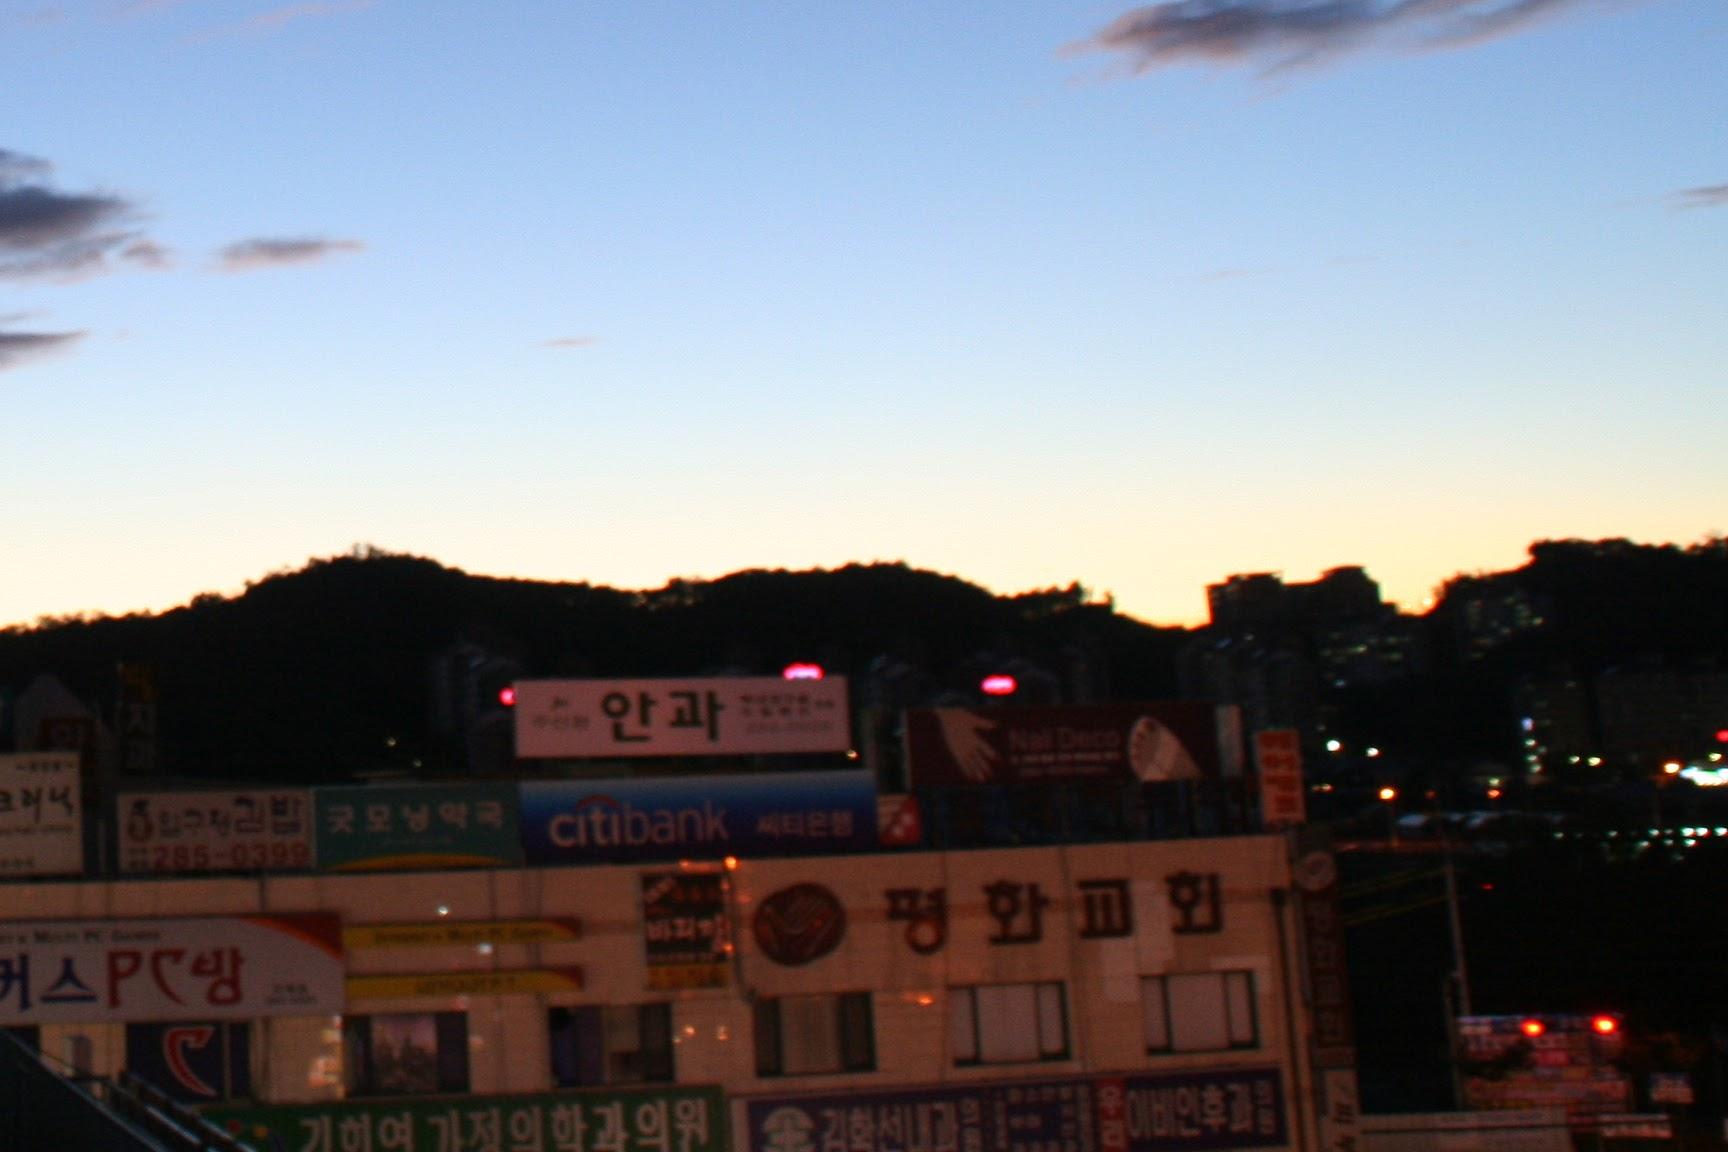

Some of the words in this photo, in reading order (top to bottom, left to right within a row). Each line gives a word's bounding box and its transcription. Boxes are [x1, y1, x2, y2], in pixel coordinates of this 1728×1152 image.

[600, 690, 726, 744] 안과
[1008, 727, 1053, 752] Nail
[1055, 725, 1122, 751] Deco
[327, 800, 505, 835] 굿모닝약국
[548, 796, 731, 848] citibank
[883, 870, 1224, 955] 평화교회
[106, 947, 247, 1010] PC방
